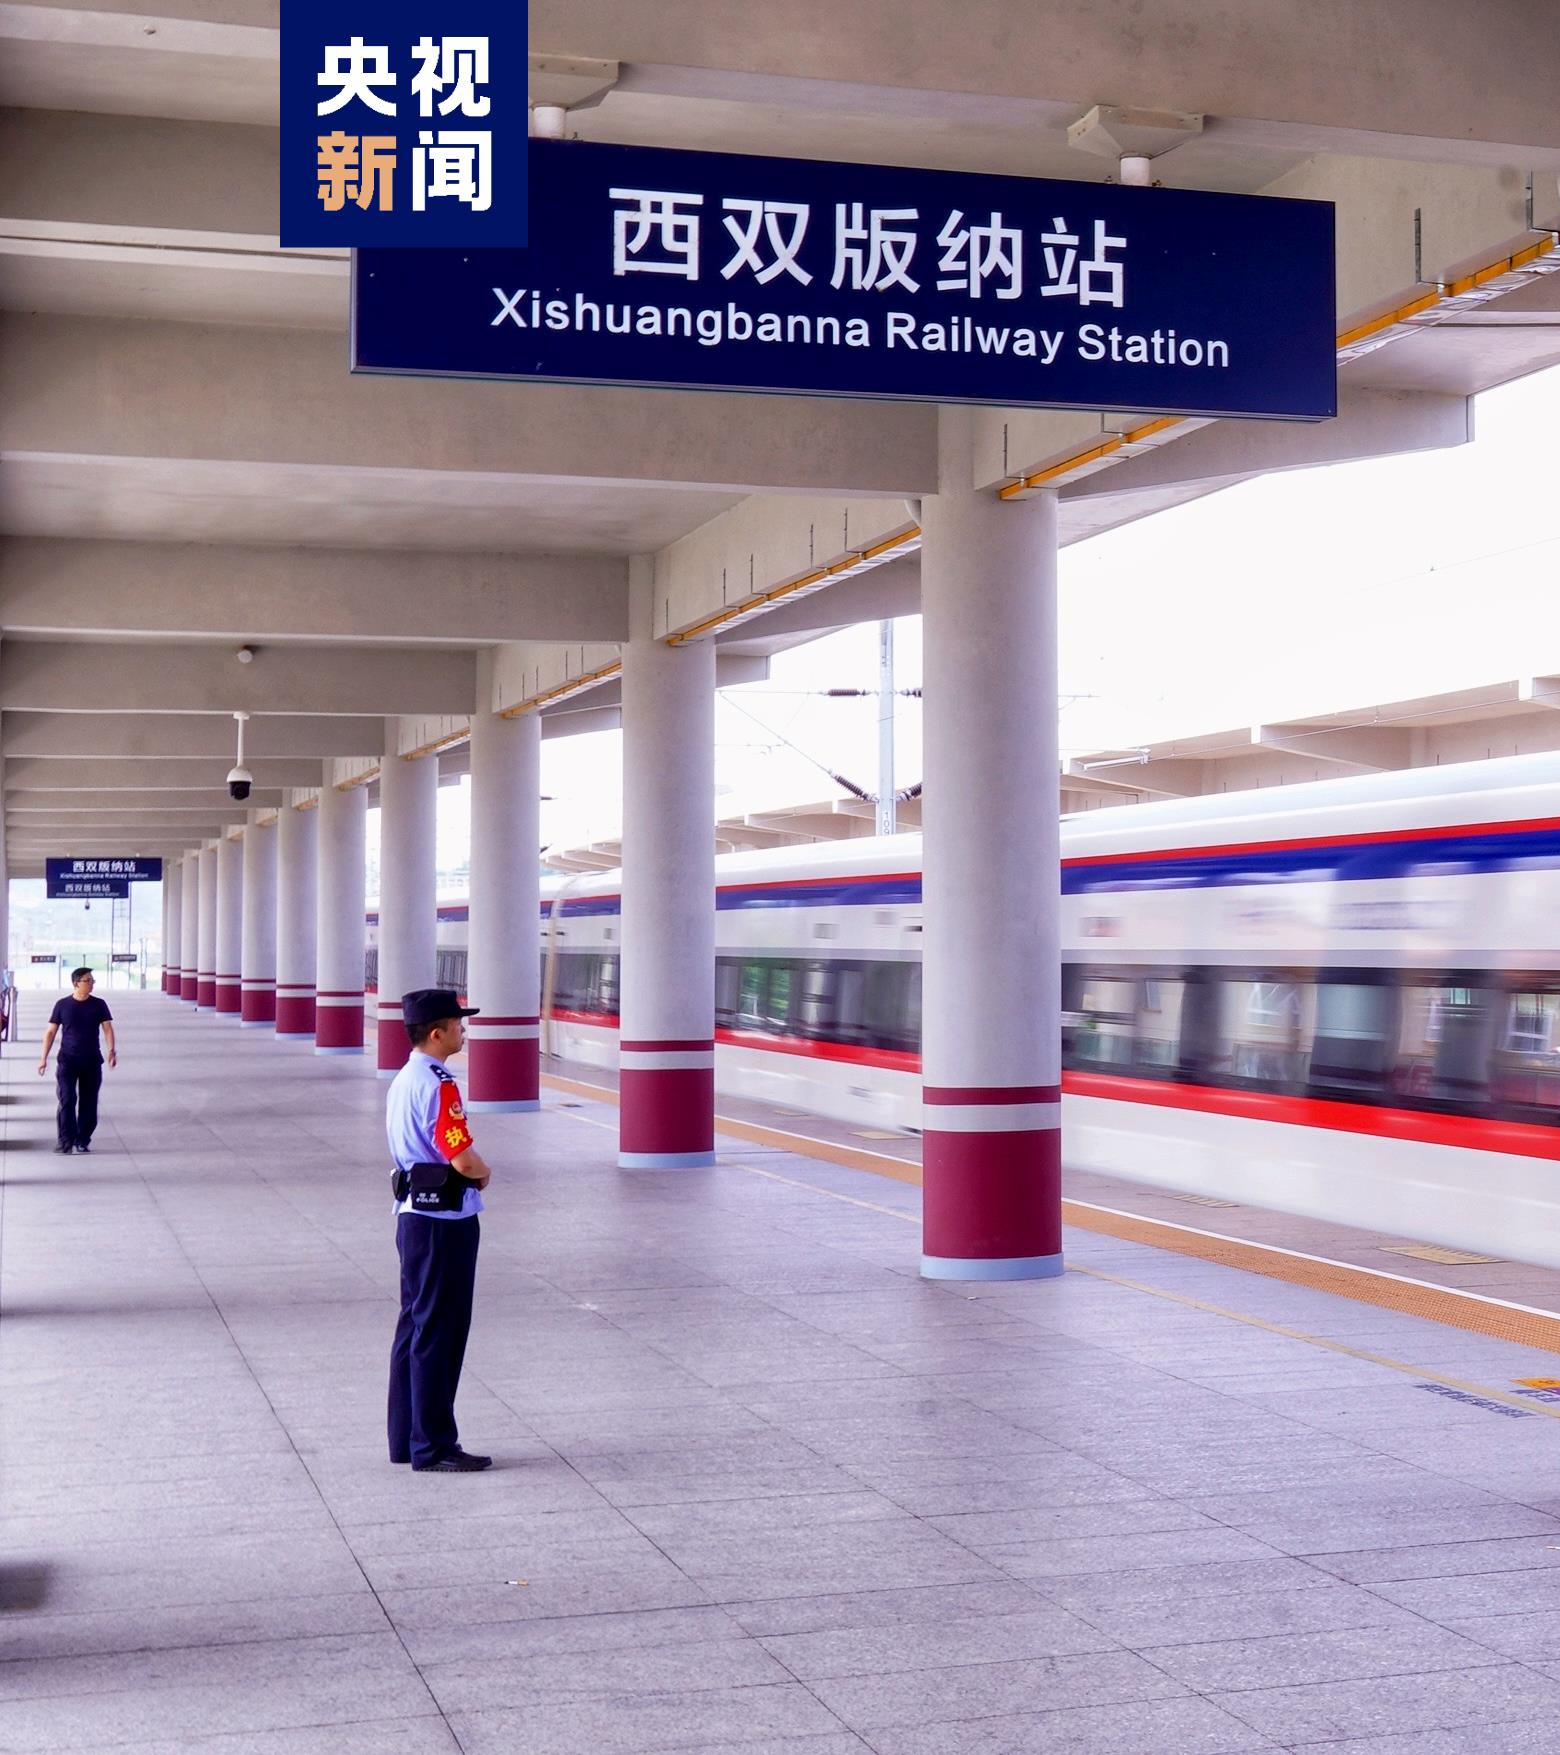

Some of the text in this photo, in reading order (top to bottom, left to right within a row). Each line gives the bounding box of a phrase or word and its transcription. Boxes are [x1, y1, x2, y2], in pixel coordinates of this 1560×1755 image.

[608, 187, 1128, 308] 西双版纳站
[489, 287, 1230, 368] Xishuangbanna Railway Station
[73, 861, 136, 872] 西双版纳站
[445, 1126, 467, 1149] 执
